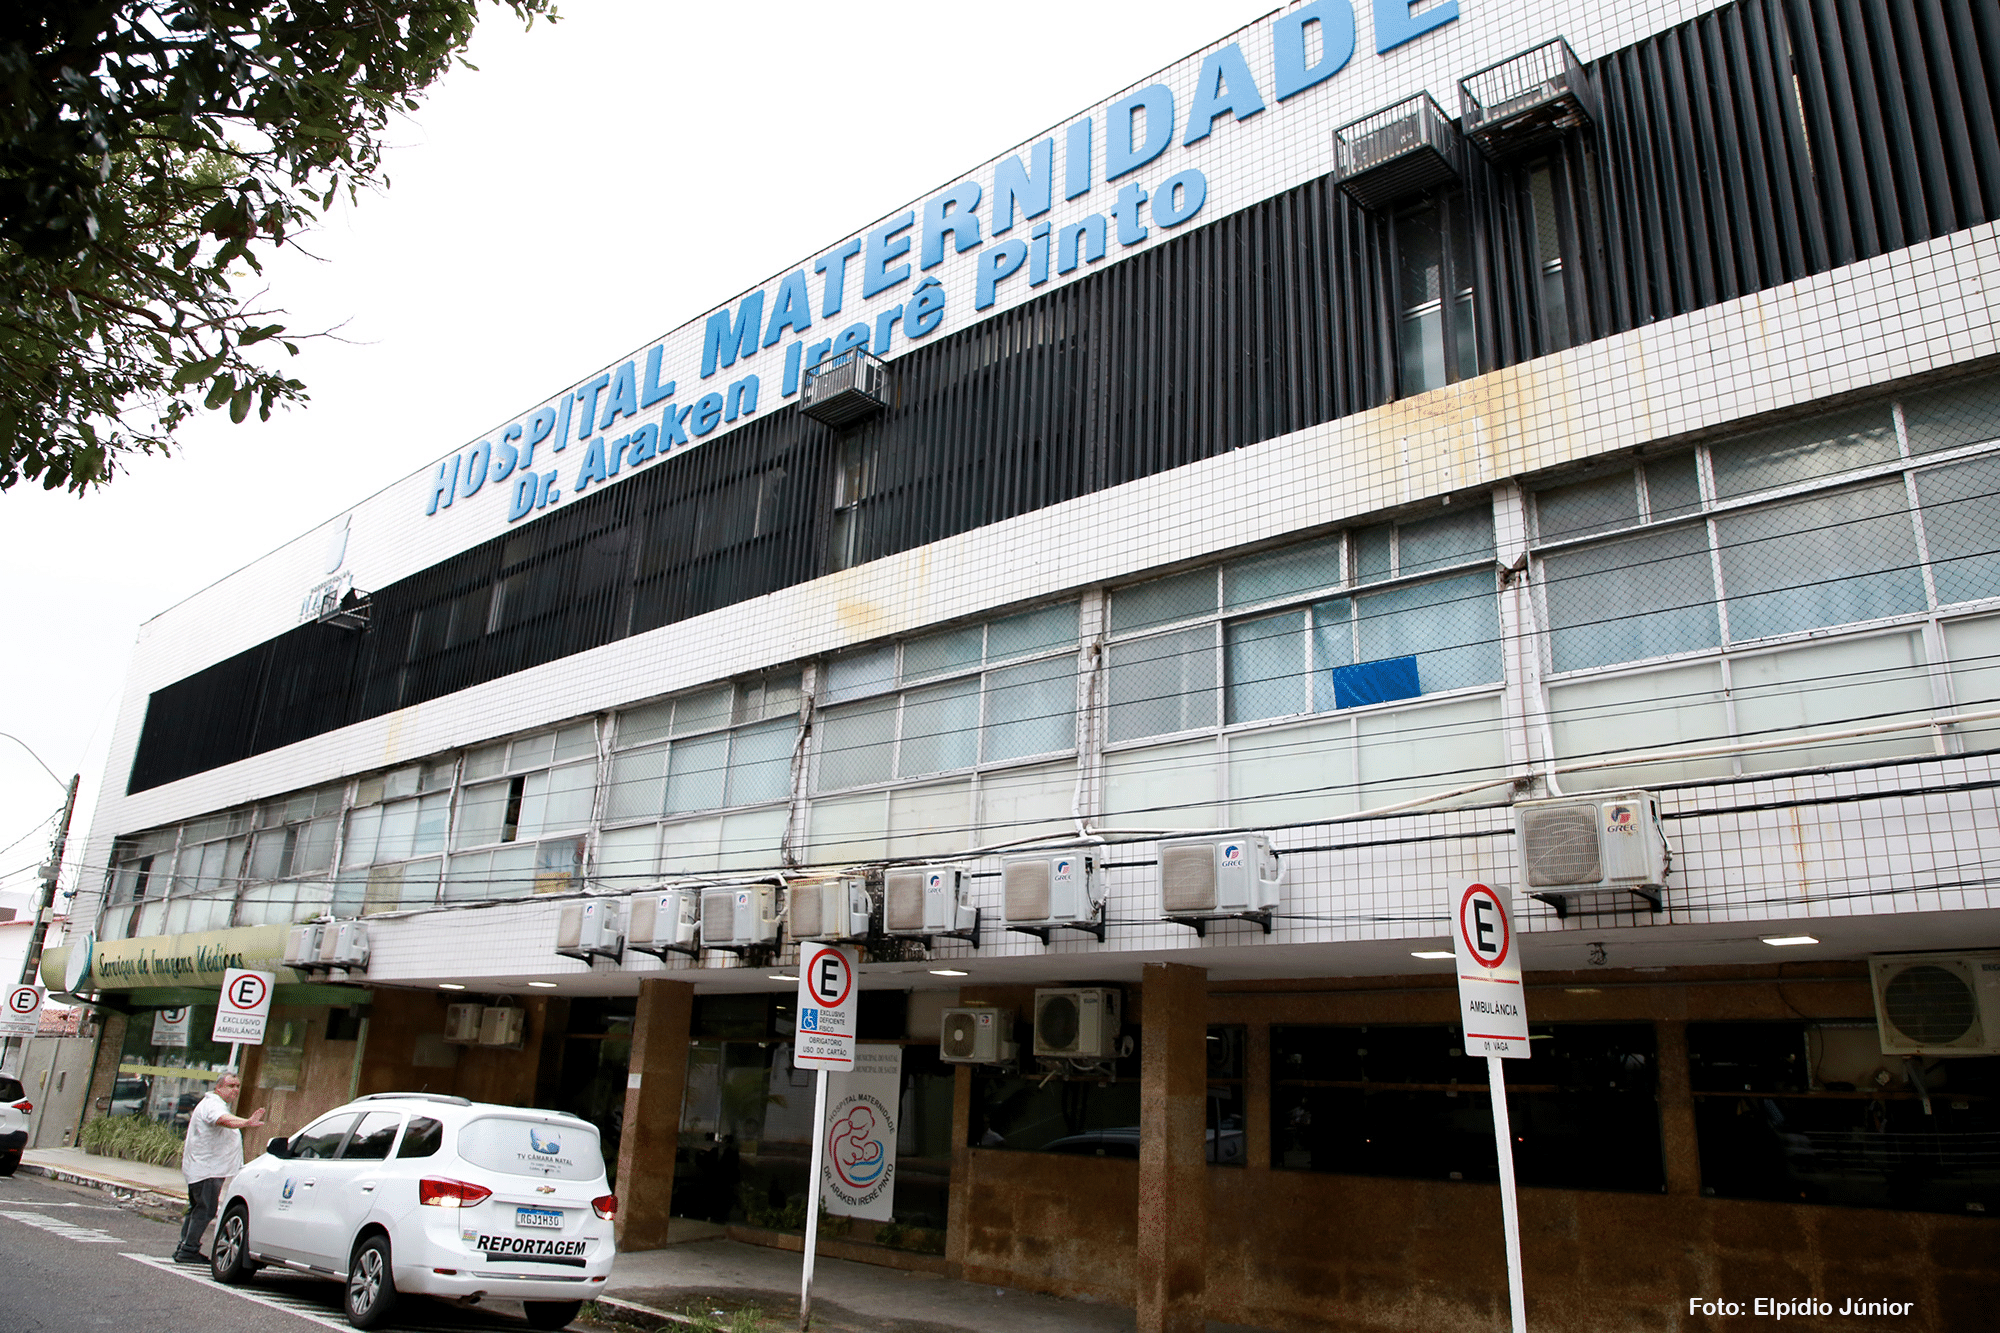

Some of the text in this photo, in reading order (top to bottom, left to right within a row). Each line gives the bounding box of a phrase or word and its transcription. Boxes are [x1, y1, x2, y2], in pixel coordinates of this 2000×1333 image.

[425, 0, 1460, 516] HOSPITAL MATERNIDADE
[507, 167, 1208, 523] Dr. Araken Irerê Pinto
[1606, 823, 1638, 833] GREE
[1221, 860, 1243, 868] GREE
[1473, 898, 1497, 953] E
[99, 943, 244, 981] Serviços de Imagens Médicas
[820, 958, 840, 998] E
[238, 980, 257, 1003] E
[17, 992, 31, 1009] E
[1469, 1000, 1519, 1017] AMBULÂNCIA
[222, 1016, 261, 1026] EXCLUSIVO
[819, 1009, 846, 1019] EXCLUSIVO
[819, 1016, 846, 1026] DEFICIENTE
[216, 1025, 262, 1036] AMBULÂNCIA
[802, 1046, 848, 1057] USO DO CARTÃO
[1493, 1040, 1509, 1052] VAGA
[828, 1093, 896, 1135] HOSPITAL MATERNIDADE
[527, 1154, 554, 1163] CÂMARA
[555, 1157, 573, 1167] NATAL
[823, 1165, 832, 1184] DR.
[830, 1183, 857, 1206] ARAKEN
[878, 1163, 894, 1194] PINTO
[477, 1234, 587, 1256] REPORTAGEM
